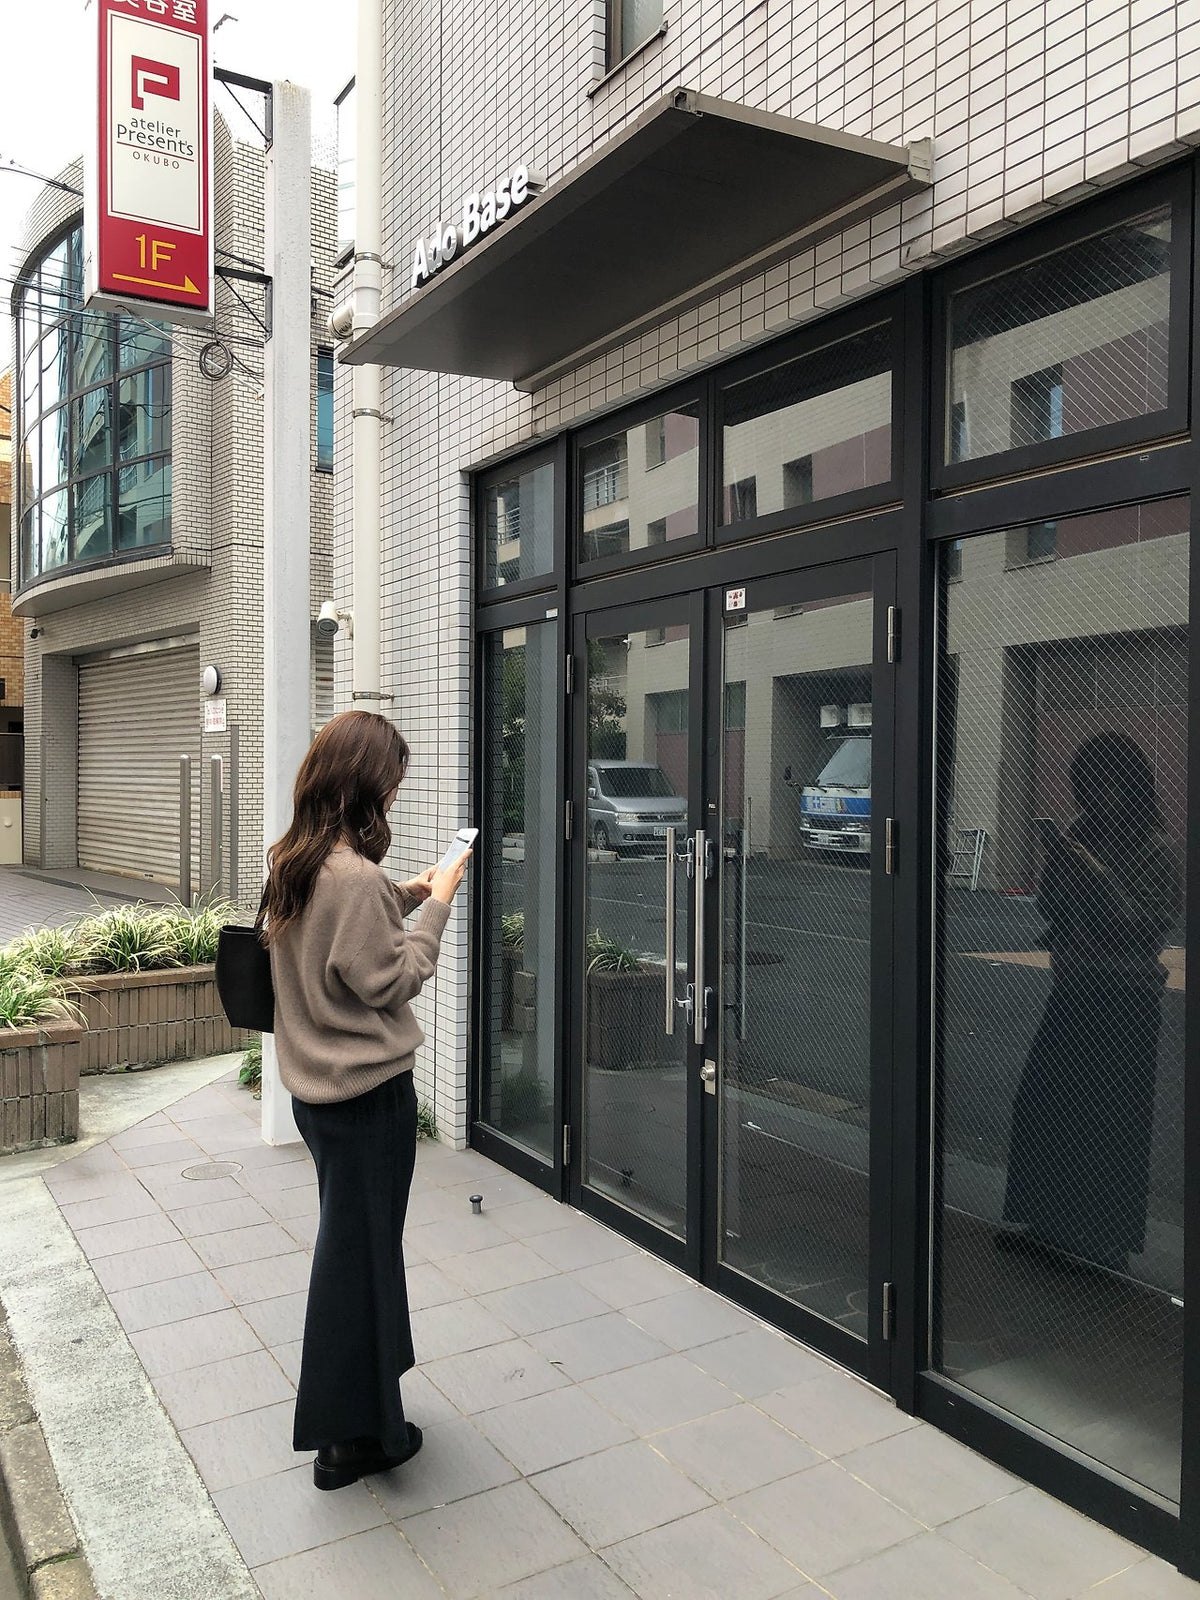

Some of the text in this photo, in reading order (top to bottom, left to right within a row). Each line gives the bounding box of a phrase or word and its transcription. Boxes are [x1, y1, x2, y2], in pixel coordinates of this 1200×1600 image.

[130, 117, 181, 138] atelier
[132, 151, 180, 170] OKUBO
[410, 165, 529, 288] Ado Base
[135, 234, 176, 271] 1F
